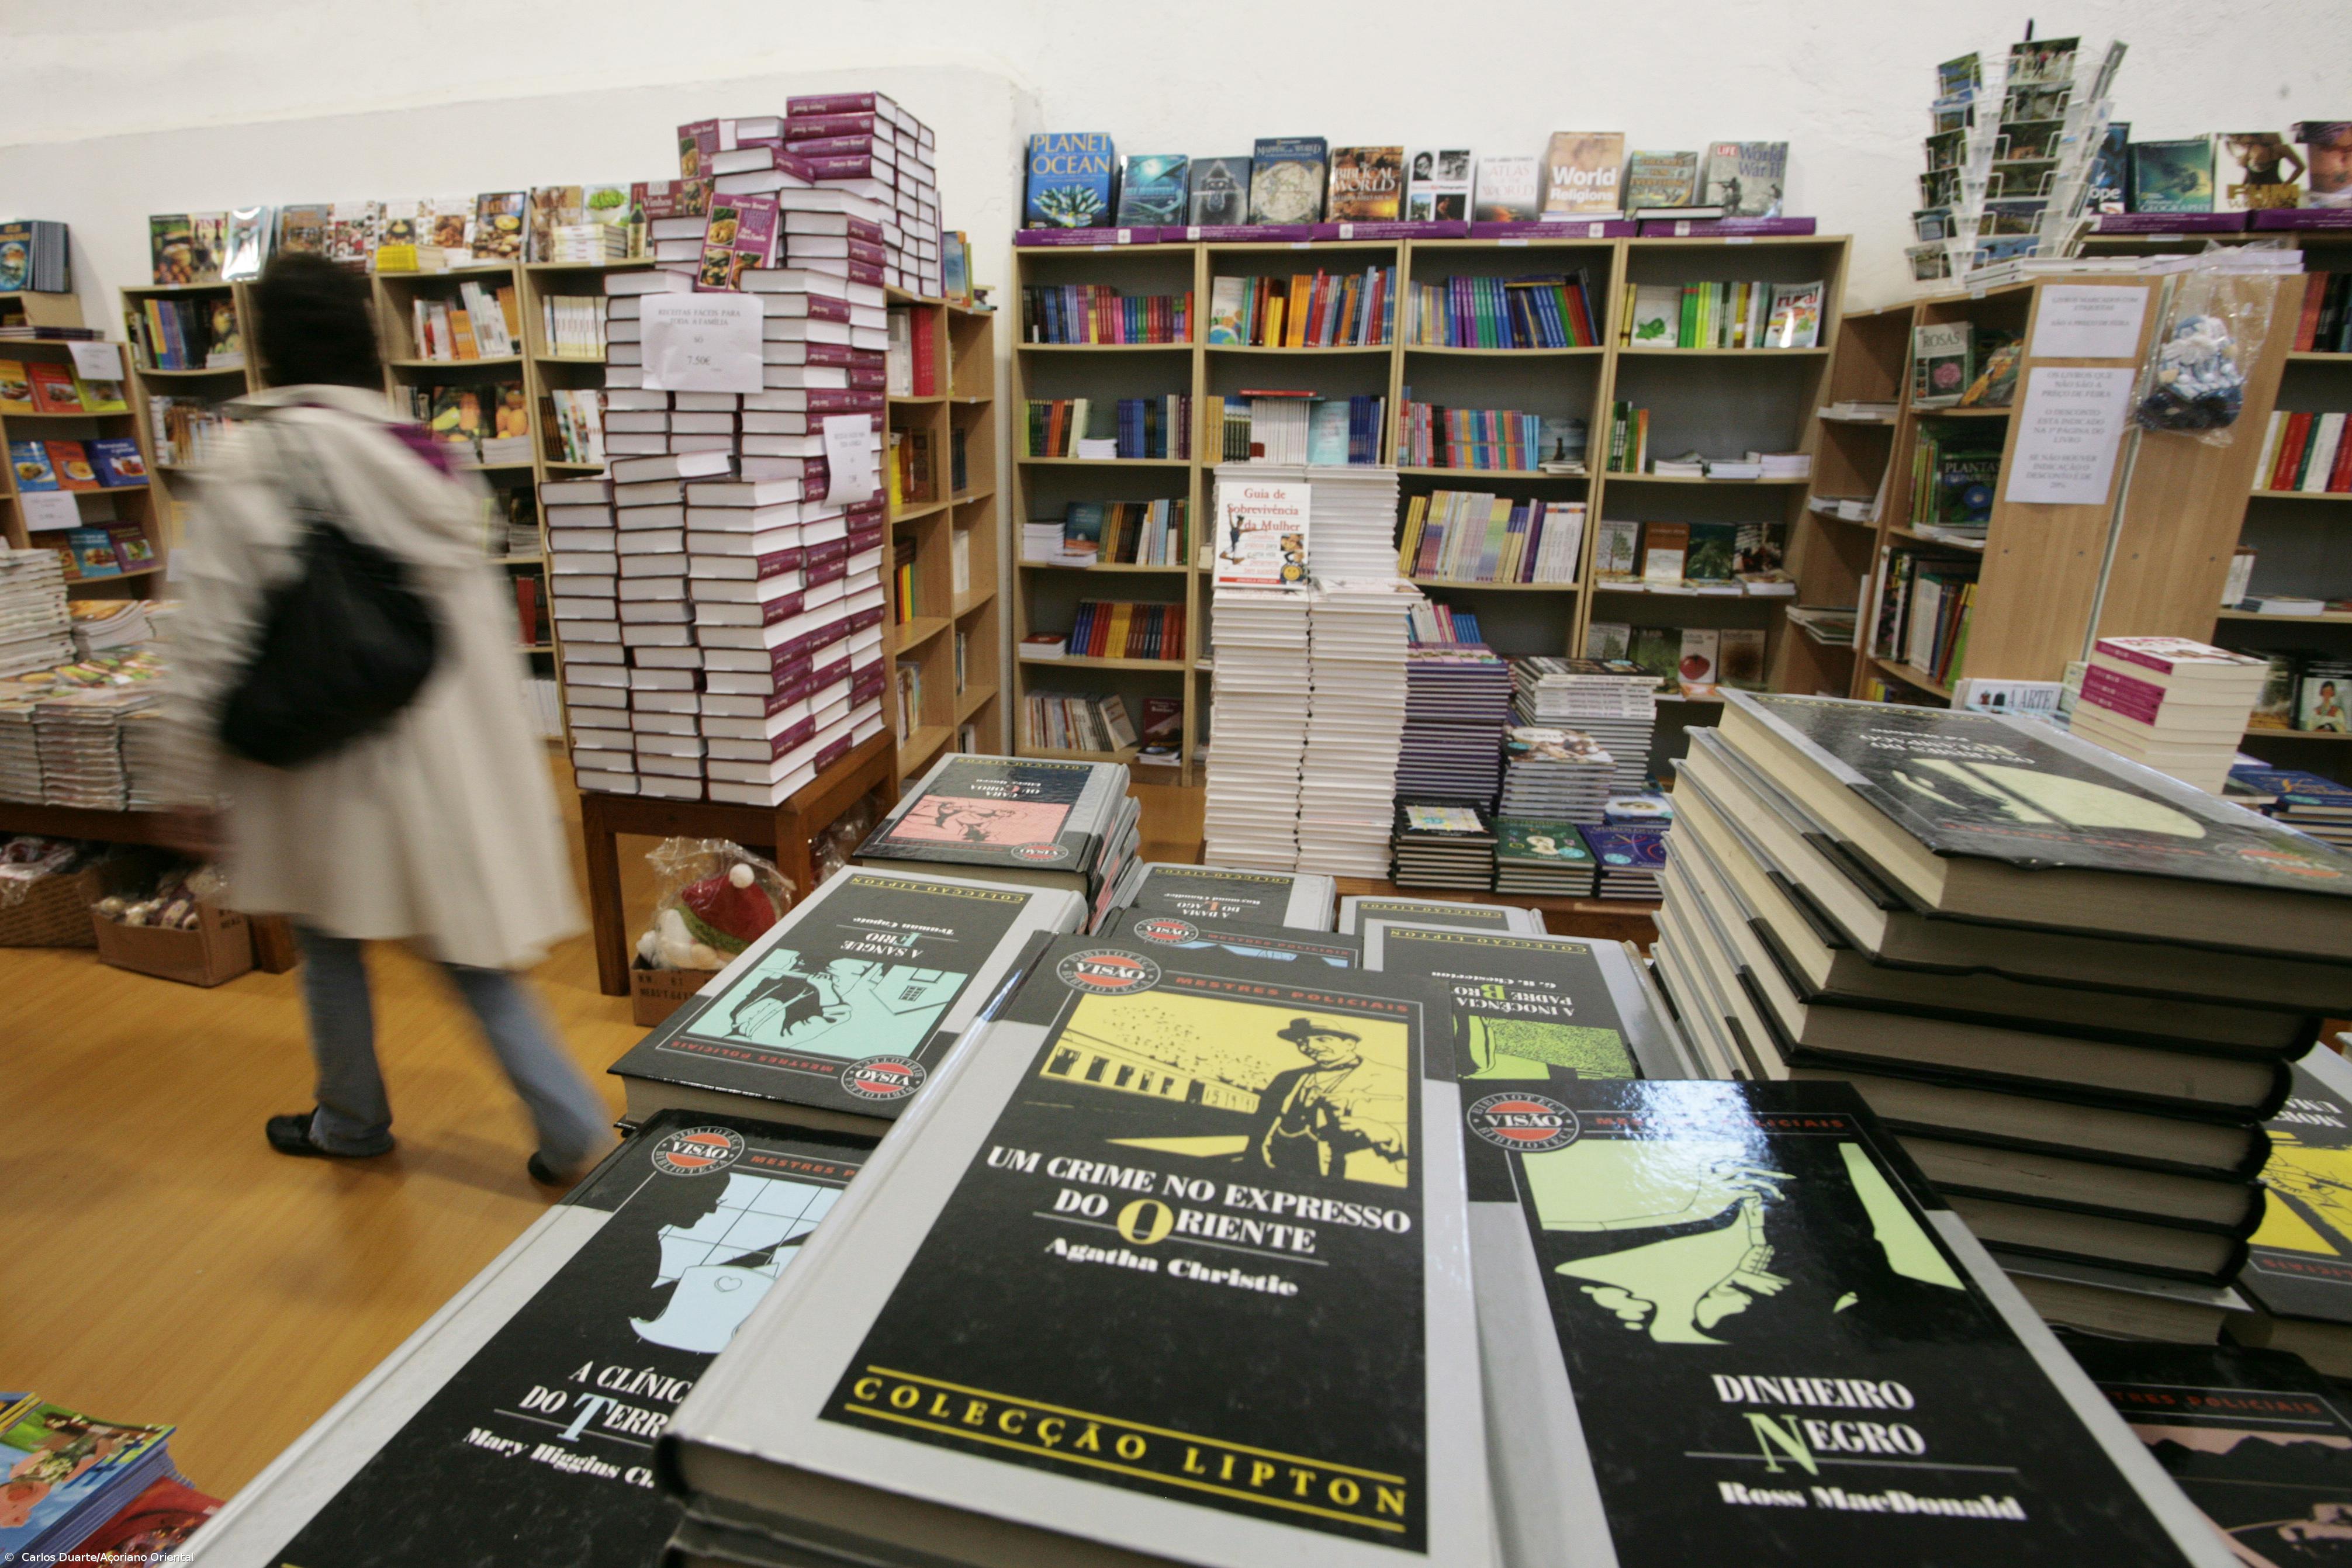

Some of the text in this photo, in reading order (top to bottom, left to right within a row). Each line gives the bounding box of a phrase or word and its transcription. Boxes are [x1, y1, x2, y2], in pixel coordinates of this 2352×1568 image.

[1033, 134, 1107, 153] PLANET
[1718, 146, 1737, 156] LIFE
[1739, 144, 1787, 162] World
[1032, 154, 1110, 175] OCEAN
[1334, 167, 1395, 180] BIBLICAL
[1490, 164, 1530, 176] ATLAS
[1739, 161, 1766, 176] War
[1333, 178, 1395, 192] WORLD
[1552, 167, 1617, 186] World
[1482, 185, 1535, 197] WORLD
[1550, 187, 1616, 203] Religions
[1777, 294, 1818, 307] rural
[1923, 333, 1960, 347] ROSAS
[1244, 488, 1286, 499] Guia de
[1227, 503, 1299, 515] Sobrevivência
[1244, 520, 1300, 532] da Mulher
[2008, 688, 2054, 710] A ARTE
[970, 784, 1021, 793] COROA
[1019, 848, 1059, 857] VISÃO
[1155, 868, 1291, 884] COLECÇÃO LIPTON
[851, 877, 1024, 902] COLECÇÃO LIPTON
[1163, 892, 1261, 905] Raymond Chandler
[1176, 901, 1240, 913] DO LAGO
[1182, 909, 1219, 918] DAMA
[1360, 902, 1503, 918] COLECÇÃO LIPTON
[852, 916, 954, 936] Truman Capote
[1146, 925, 1189, 936] VISÃO
[841, 940, 924, 959] A SANGUE
[865, 932, 923, 948] FRIO
[1208, 933, 1350, 956] MESTRES POLICIAIS
[1391, 928, 1588, 953] COLECÇÃO LIPTON
[1069, 950, 1156, 979] BIBLIOTECA
[1076, 961, 1146, 981] VISÃO
[1060, 970, 1152, 993] BIBLIOTECA
[1431, 971, 1514, 985] Chesterton
[1175, 977, 1409, 1013] MESTRES POLICIAIS
[1453, 984, 1573, 1006] PADRE BRO
[1455, 997, 1575, 1017] A INOCÊNCIA
[670, 1040, 835, 1074] POLICIAIS MESTRES
[855, 1068, 910, 1087] VISÃO
[1474, 1093, 1566, 1116] BIBLIOTECA
[1485, 1112, 1563, 1129] VISÃO
[671, 1127, 741, 1151] BIBLIOTECA
[1479, 1126, 1575, 1150] BIBLIOTECA
[672, 1140, 729, 1159] VISÃO
[655, 1150, 729, 1175] BIBLIOTECA
[750, 1155, 836, 1175] MESTRES
[987, 1145, 1413, 1235] UM CRIME NO EXPRESSO
[1053, 1187, 1317, 1255] DO ORIENTE
[1044, 1235, 1300, 1299] Agatha Christie
[568, 1361, 693, 1406] A CLÍNIC
[1711, 1373, 1915, 1411] DINHEIRO
[518, 1385, 667, 1443] DO TERR
[2185, 1395, 2322, 1414] POLICIAIS
[853, 1376, 1409, 1516] COLECÇÃO LIPTON
[1742, 1411, 1926, 1476] NEGRO
[462, 1427, 621, 1482] Mary Higgins
[1717, 1481, 2029, 1521] Ross MacDonald
